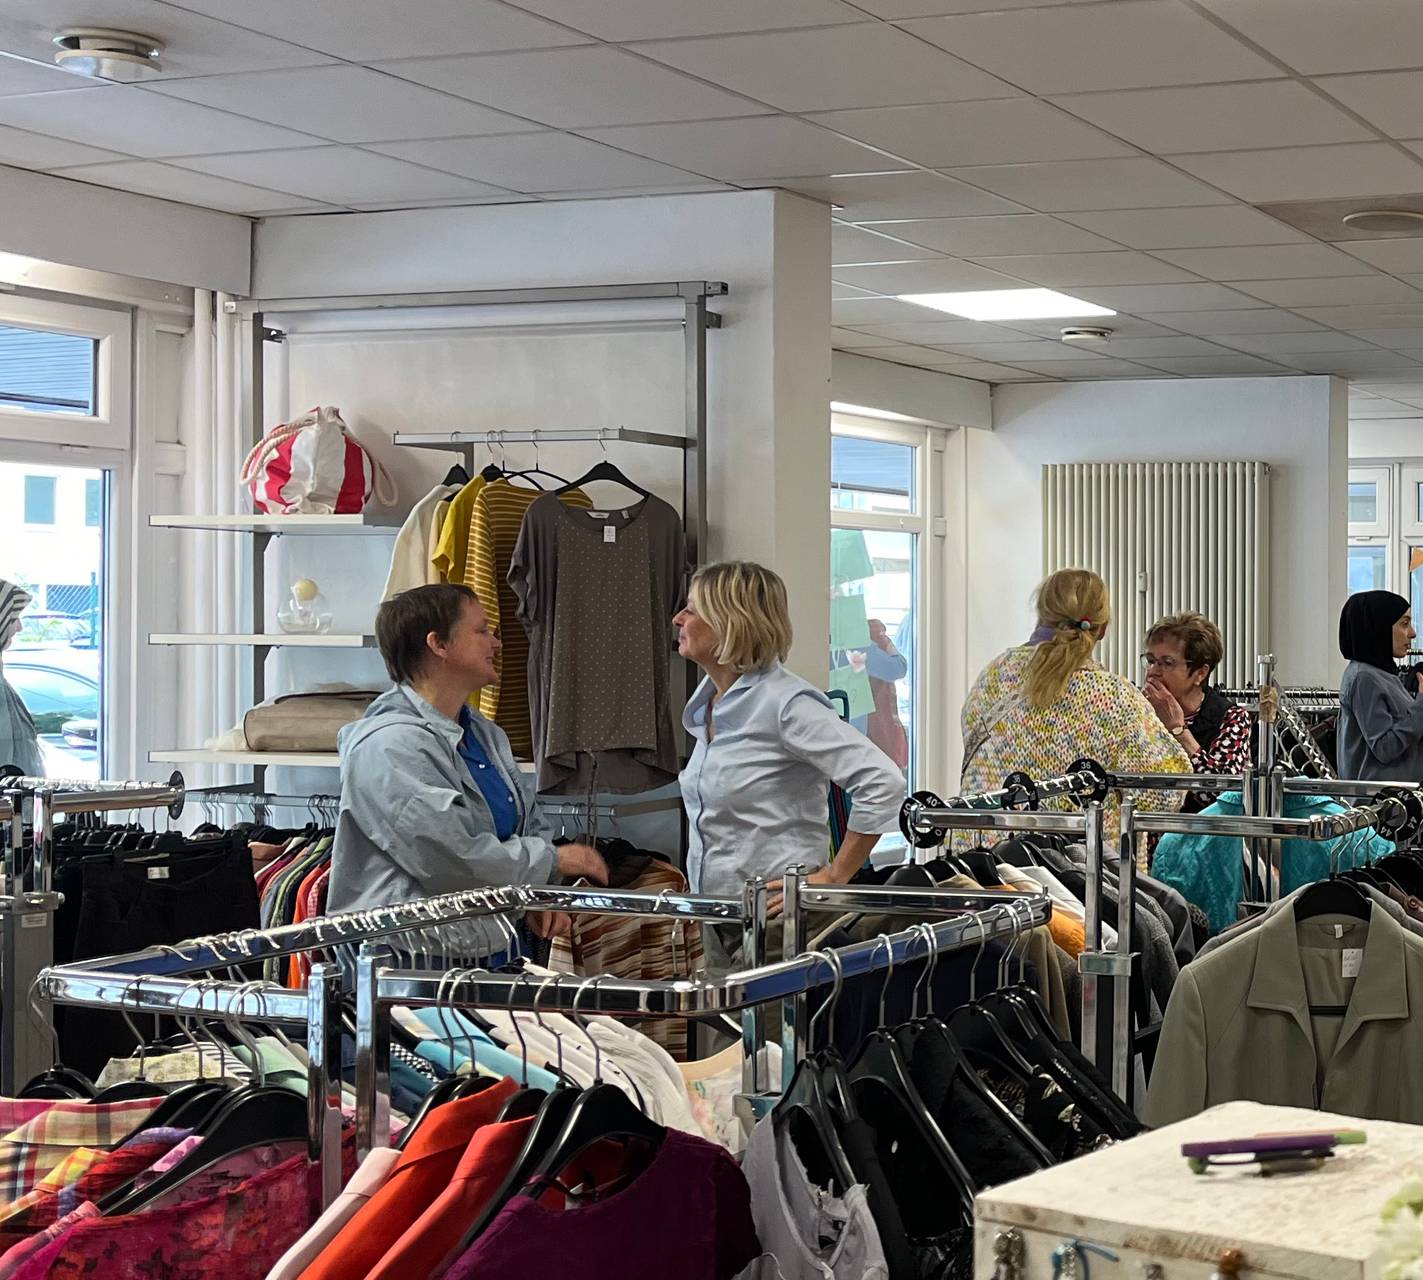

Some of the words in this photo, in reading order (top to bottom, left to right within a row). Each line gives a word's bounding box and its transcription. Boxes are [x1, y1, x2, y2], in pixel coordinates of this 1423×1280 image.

[1081, 761, 1092, 770] 36
[1397, 790, 1410, 801] 44
[925, 796, 938, 807] 40
[1406, 815, 1418, 830] 44
[1380, 825, 1393, 837] 44
